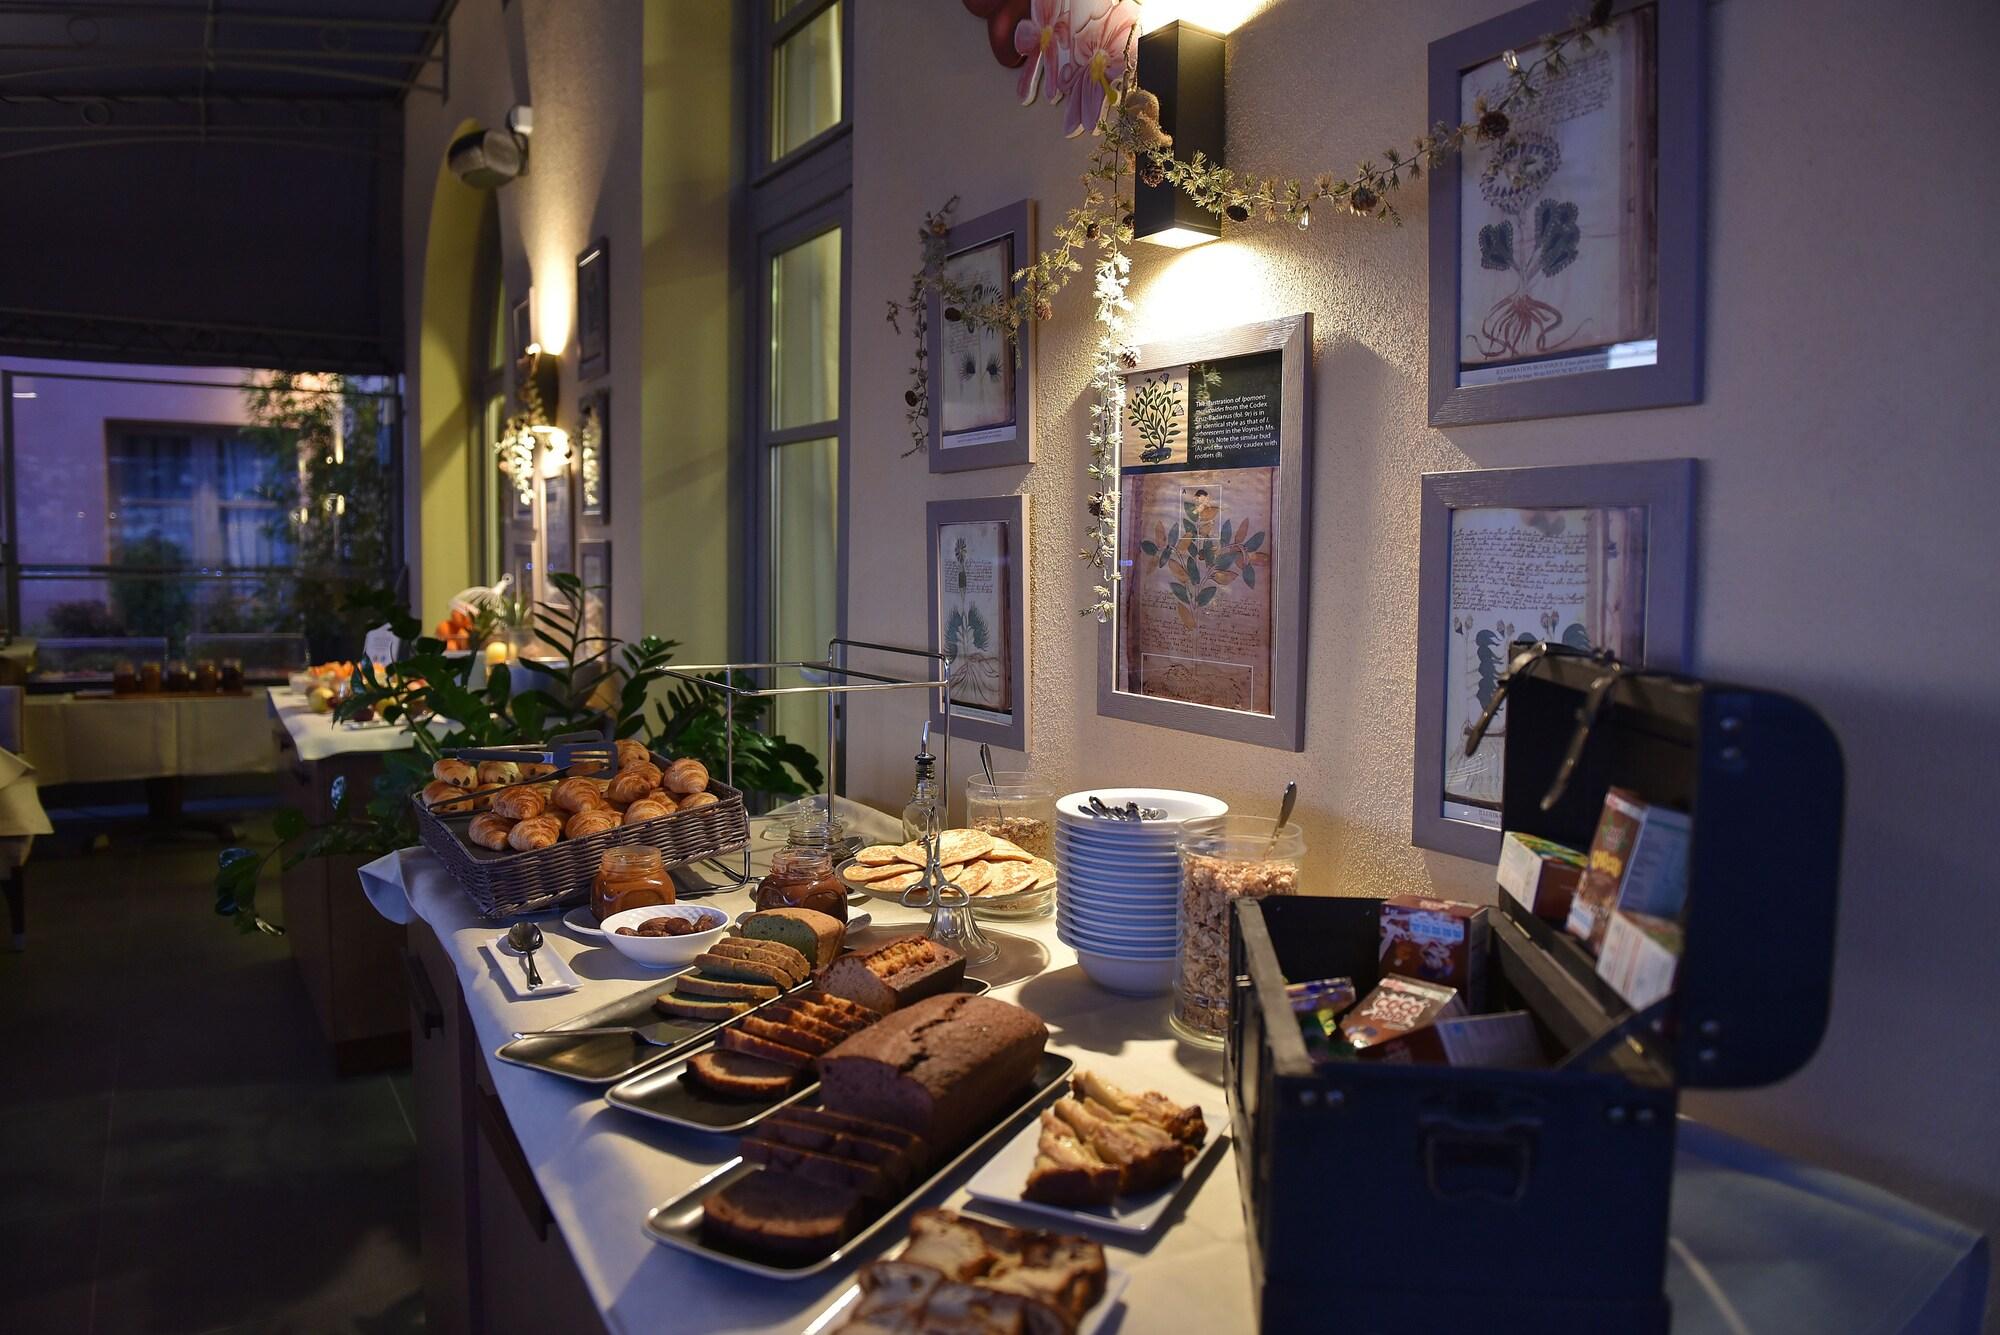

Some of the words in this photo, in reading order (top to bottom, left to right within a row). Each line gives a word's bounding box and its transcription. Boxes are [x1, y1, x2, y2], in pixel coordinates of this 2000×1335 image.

[1250, 401, 1267, 409] Codex
[1203, 420, 1225, 429] identical
[1226, 419, 1239, 428] style
[1241, 424, 1264, 434] Voynich
[1216, 435, 1229, 443] Note
[1240, 432, 1258, 441] similar
[1224, 441, 1242, 450] woody
[1243, 440, 1263, 448] caudex
[1264, 439, 1277, 447] with
